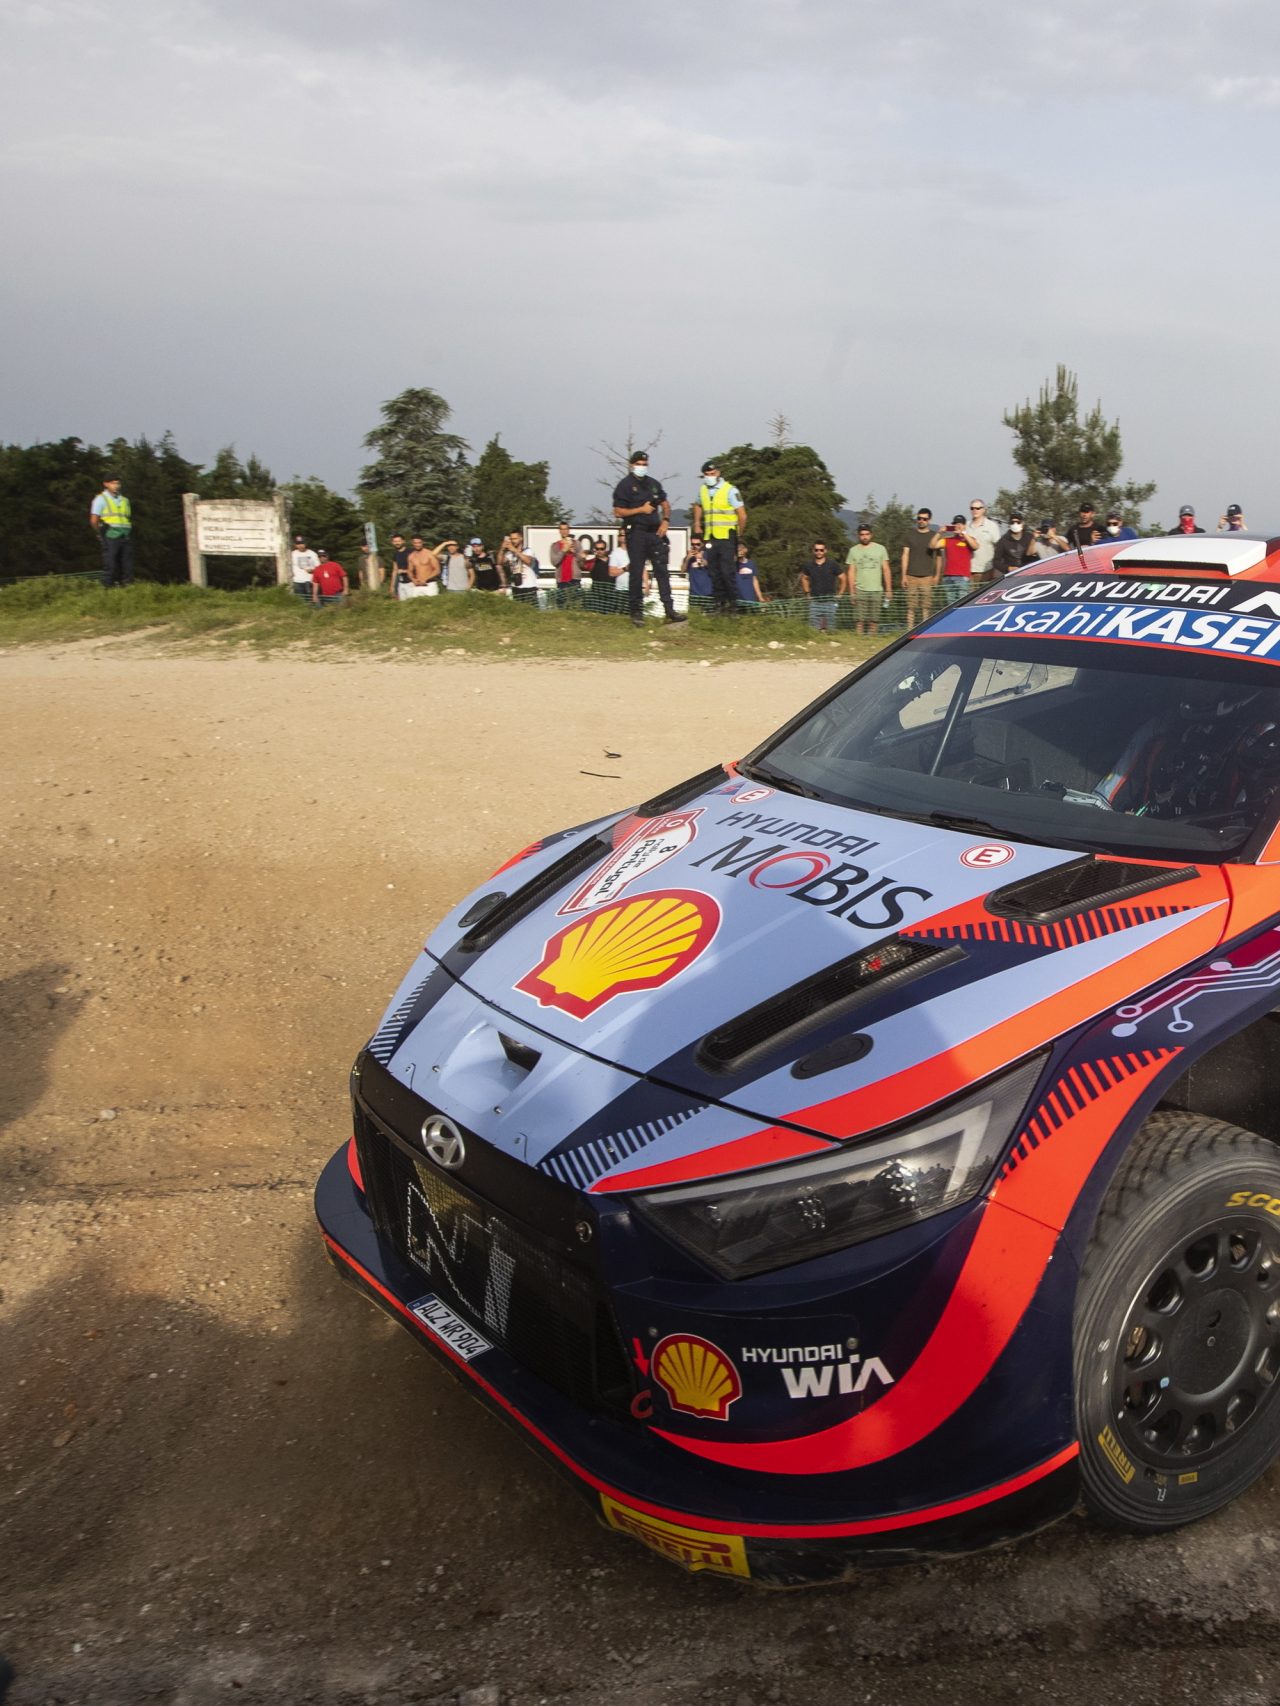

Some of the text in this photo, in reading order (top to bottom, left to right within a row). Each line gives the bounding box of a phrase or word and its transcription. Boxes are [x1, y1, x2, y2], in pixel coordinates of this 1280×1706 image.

[1061, 581, 1231, 605] HYUNDAI
[659, 845, 677, 854] 8
[715, 811, 880, 857] HYUNDAI
[595, 839, 656, 897] Portugal
[974, 847, 1002, 863] E
[689, 835, 934, 930] MOBIS
[418, 1302, 452, 1325] ALZ
[451, 1332, 486, 1355] 904
[742, 1343, 842, 1363] HYUNDAI
